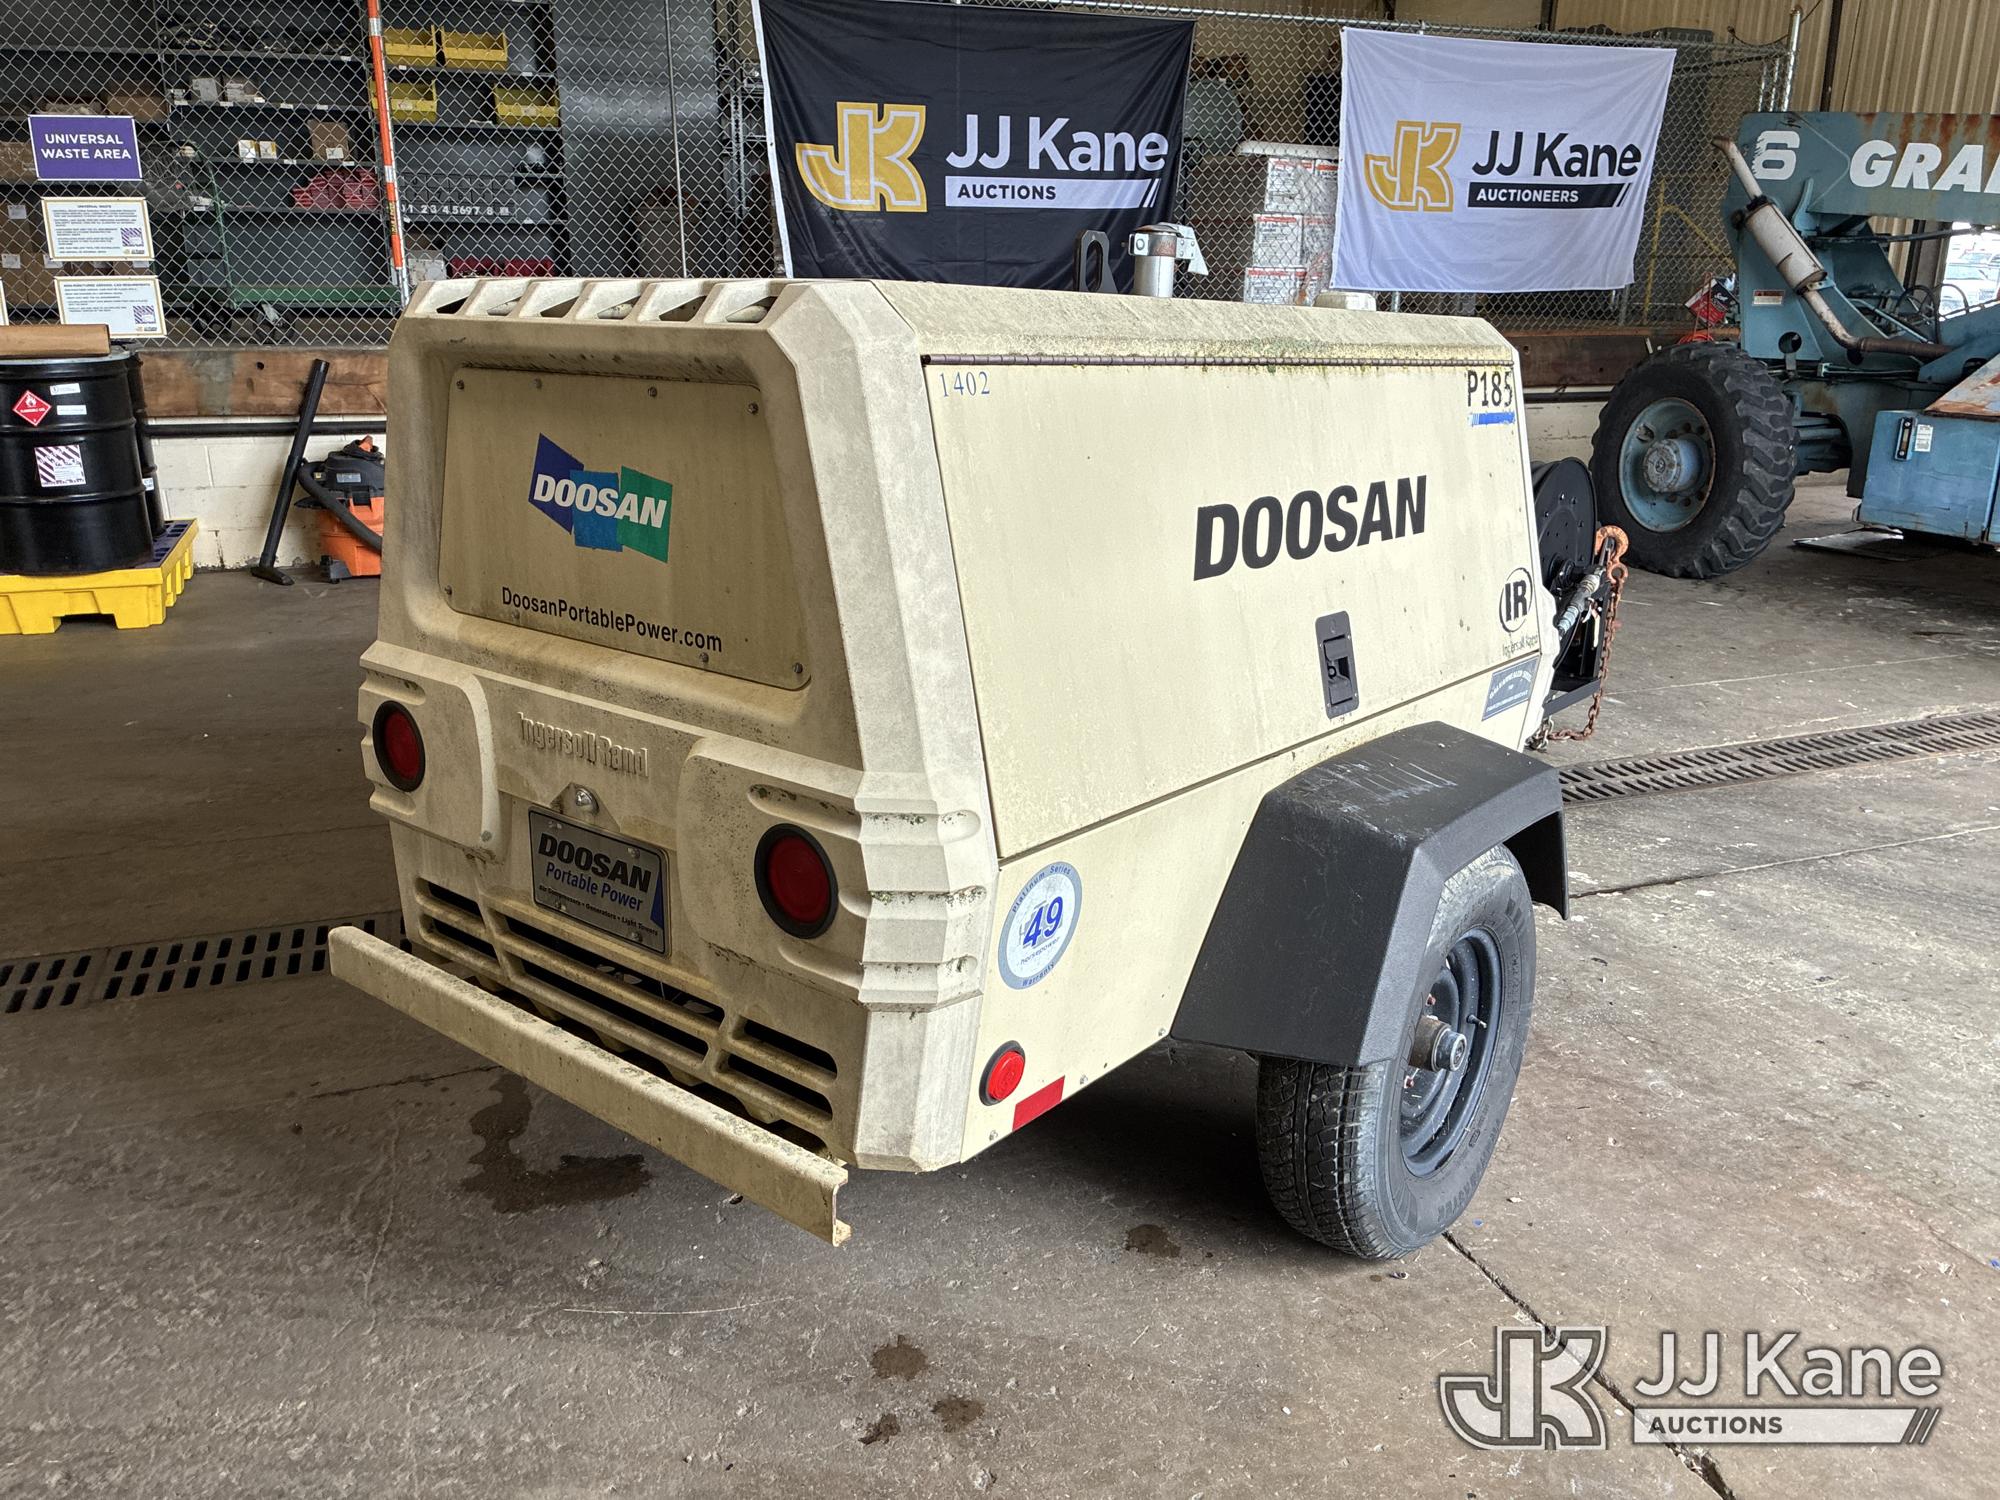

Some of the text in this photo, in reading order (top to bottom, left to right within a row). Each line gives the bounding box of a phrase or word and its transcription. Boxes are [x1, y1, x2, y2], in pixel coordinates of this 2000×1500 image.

[41, 148, 132, 159] WASTE AREA
[44, 133, 124, 145] UNIVERSAL
[946, 114, 1169, 172] JJ Kane
[1472, 130, 1641, 178] JJ Kane
[1752, 130, 1800, 180] 6
[957, 184, 1057, 201] AUCTIONS
[1476, 188, 1579, 204] AUCTIONEERS
[940, 371, 990, 397] 1402
[1467, 370, 1513, 407] P185
[533, 473, 668, 529] DOOSAN
[1193, 474, 1427, 582] DOOSAN
[501, 586, 723, 653] DoosanPortablePower.com
[1505, 580, 1528, 622] IR
[538, 832, 652, 893] DOOSAN
[546, 862, 644, 911] Portable Power
[1049, 865, 1071, 876] Series
[1023, 896, 1064, 947] 49
